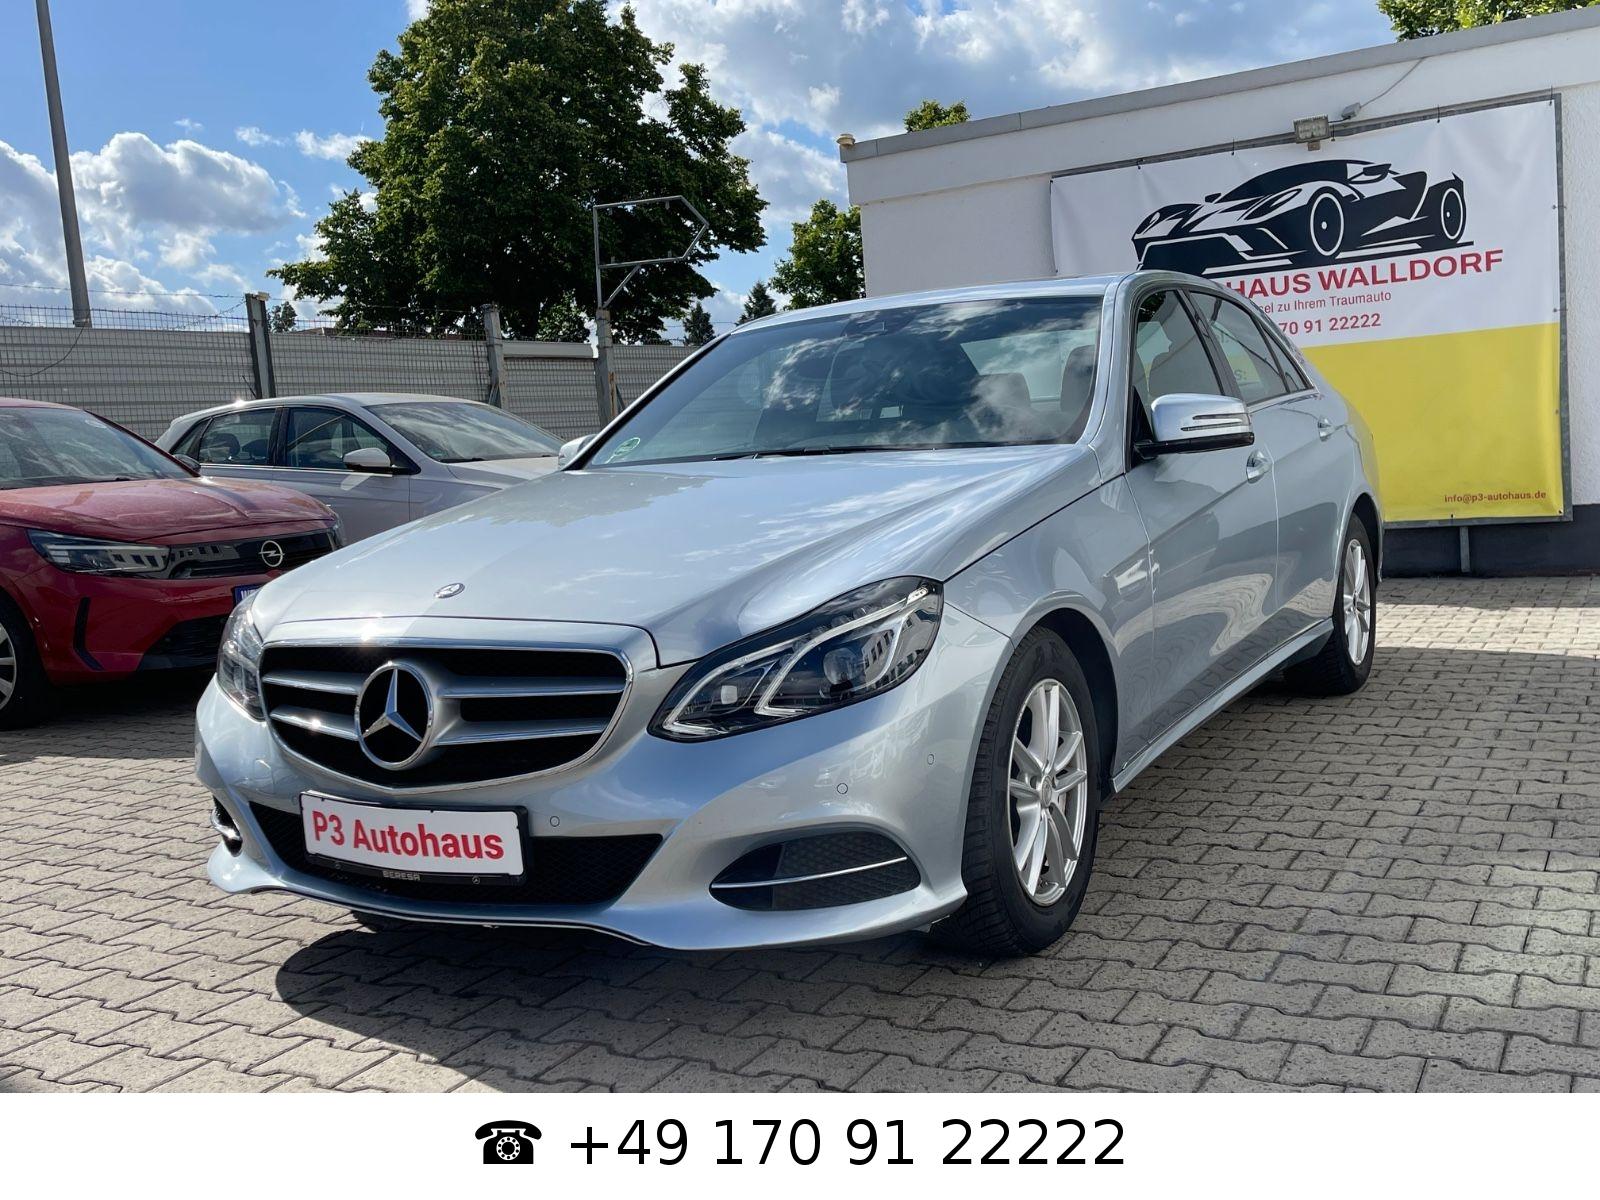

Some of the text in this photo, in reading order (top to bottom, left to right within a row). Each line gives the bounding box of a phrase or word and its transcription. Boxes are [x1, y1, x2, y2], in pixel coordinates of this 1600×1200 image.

[1318, 249, 1504, 291] WALLDORF
[1278, 302, 1291, 312] zu
[1294, 297, 1326, 311] Ihrem
[1329, 291, 1392, 307] Traumauto
[1279, 313, 1381, 335] 70 91 22222
[1444, 490, 1547, 504] info@p3-autohaus.de
[312, 810, 504, 860] P3 Autohaus
